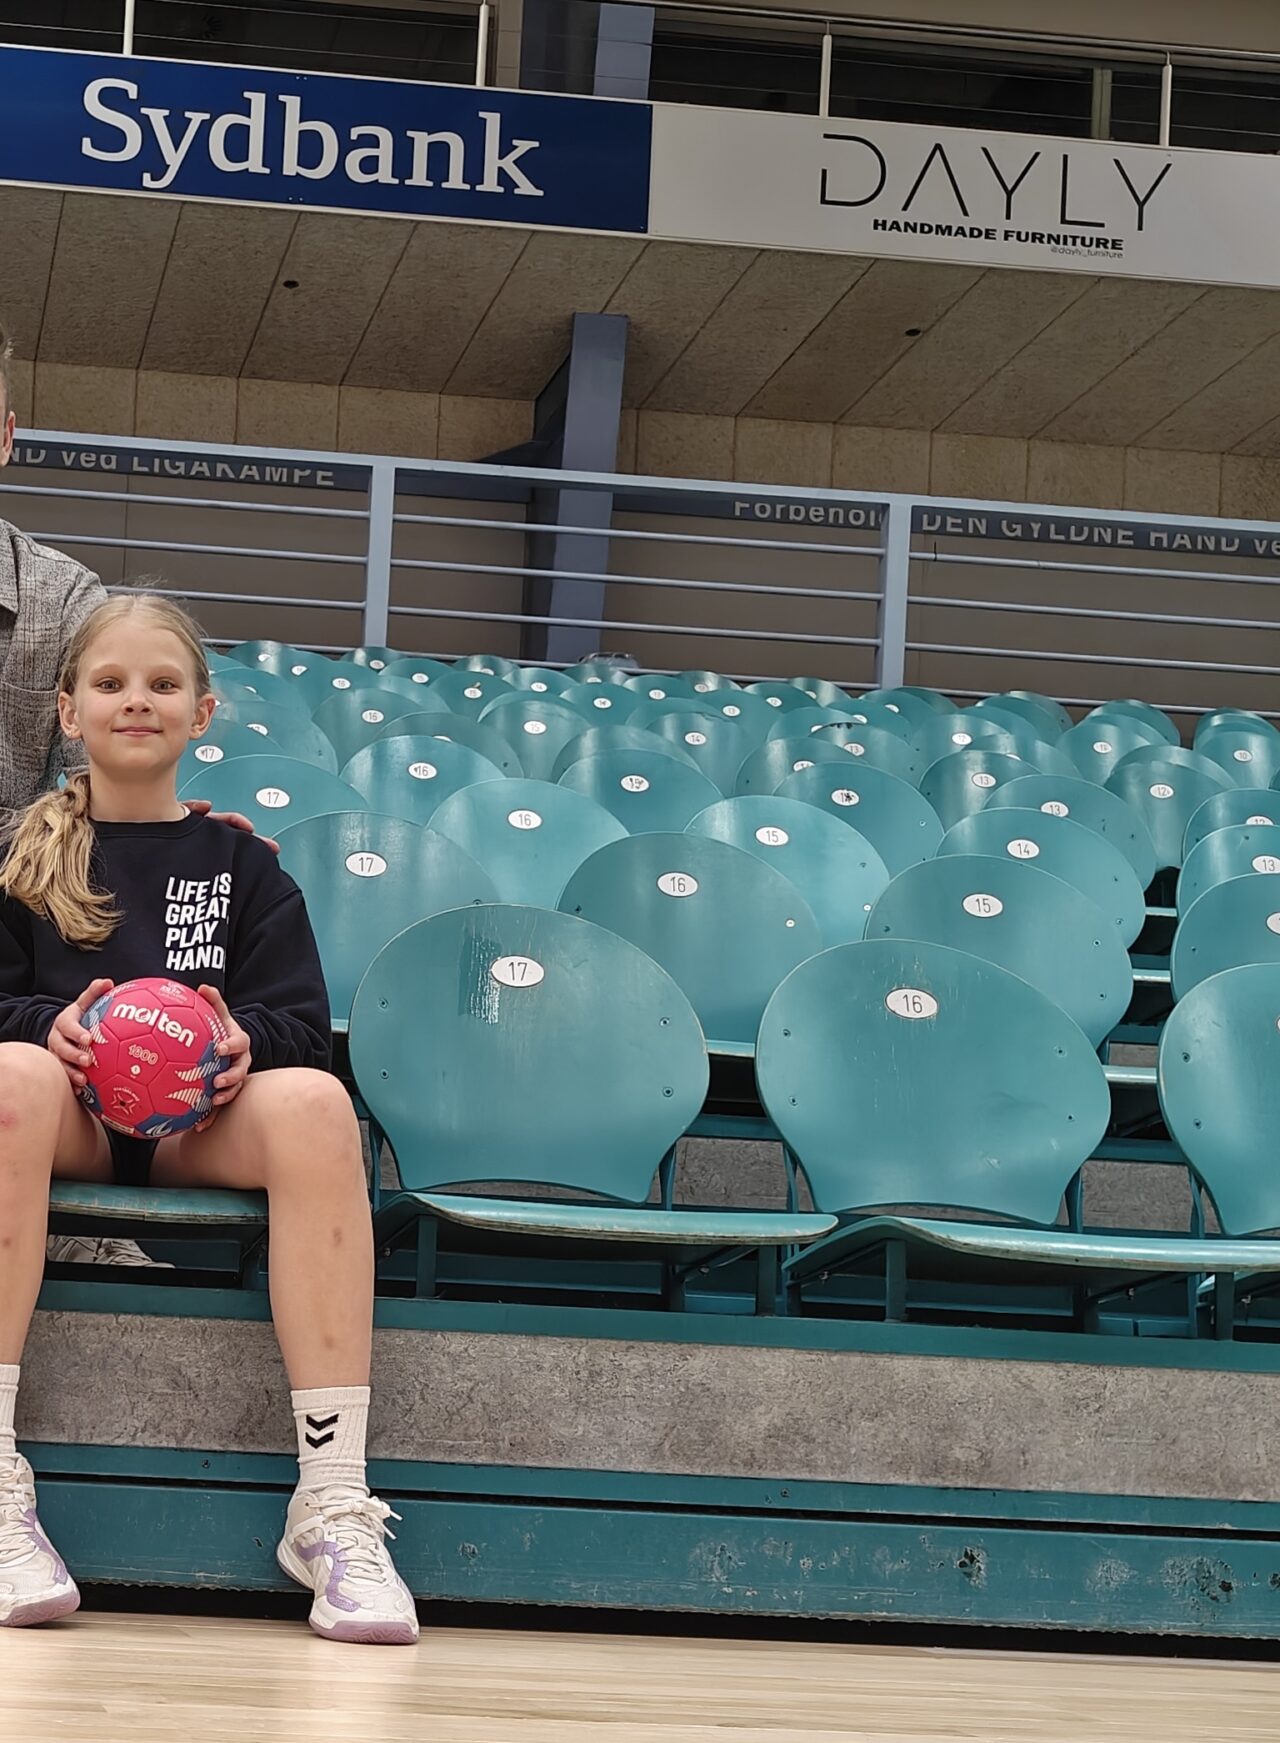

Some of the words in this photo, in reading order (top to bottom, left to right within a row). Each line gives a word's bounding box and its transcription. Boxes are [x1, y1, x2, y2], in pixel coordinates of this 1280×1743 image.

[81, 77, 544, 197] Sydbank
[820, 133, 1173, 231] DAYLY
[872, 218, 997, 240] HANDMADE
[1003, 229, 1124, 251] FURNITURE
[367, 711, 378, 721] 16
[980, 775, 990, 786] 13
[266, 791, 280, 805] 17
[1049, 804, 1061, 817] 13
[518, 812, 532, 827] 16
[766, 828, 780, 843] 15
[1017, 842, 1031, 857] 14
[357, 856, 374, 873] 17
[1261, 858, 1276, 873] 13
[165, 876, 210, 902] LIFE
[211, 872, 232, 896] IS
[670, 876, 686, 893] 16
[975, 897, 992, 914] 15
[165, 920, 219, 949] PLAY
[507, 961, 528, 981] 17
[901, 993, 924, 1014] 16
[112, 1002, 195, 1048] molten
